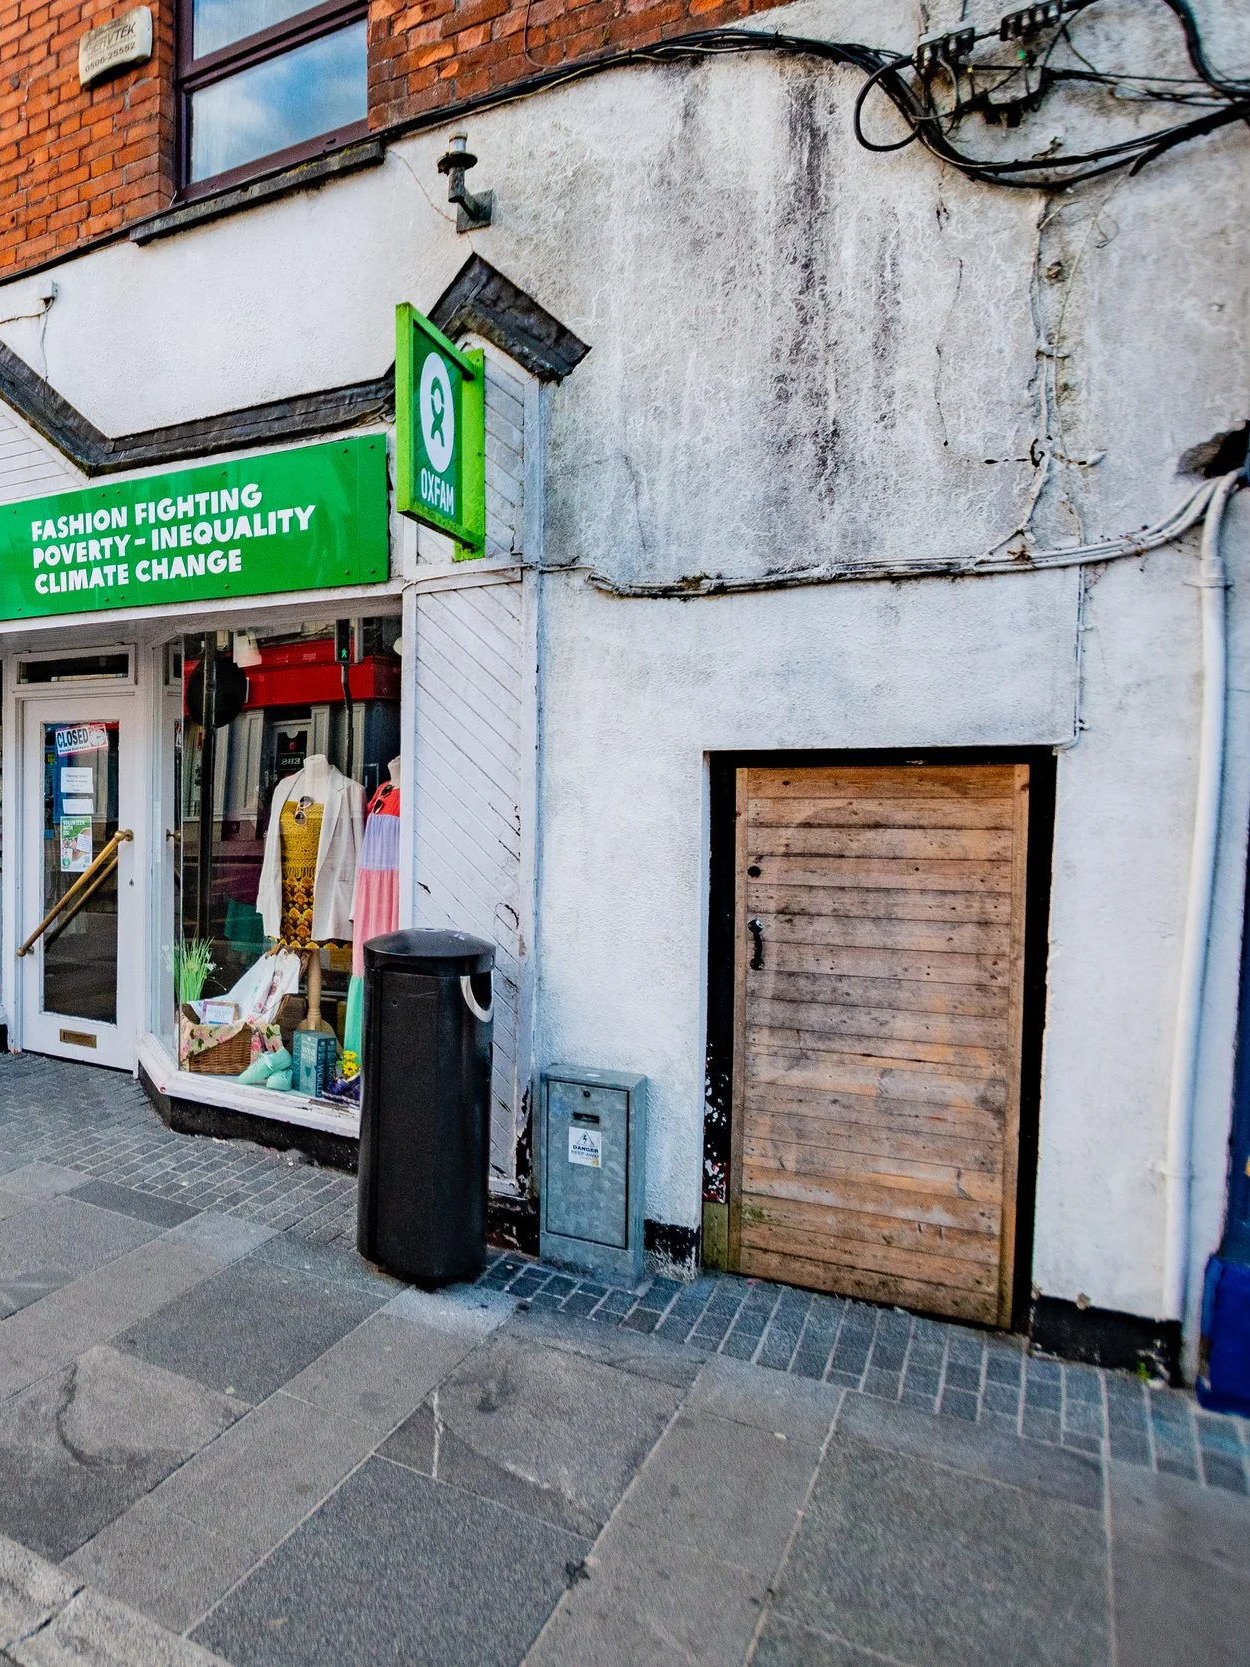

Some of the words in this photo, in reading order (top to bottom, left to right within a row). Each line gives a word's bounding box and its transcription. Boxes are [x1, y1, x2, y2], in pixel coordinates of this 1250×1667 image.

[31, 506, 128, 542] FASHION
[134, 483, 263, 526] FIGHTING
[421, 467, 454, 515] OXFAM
[32, 534, 132, 569] POVERTY
[151, 504, 317, 552] INEQUALITY
[34, 563, 130, 595] CLIMATE
[135, 548, 243, 583] CHANGE
[56, 728, 89, 748] CLOSED
[573, 1145, 598, 1153] DANGER
